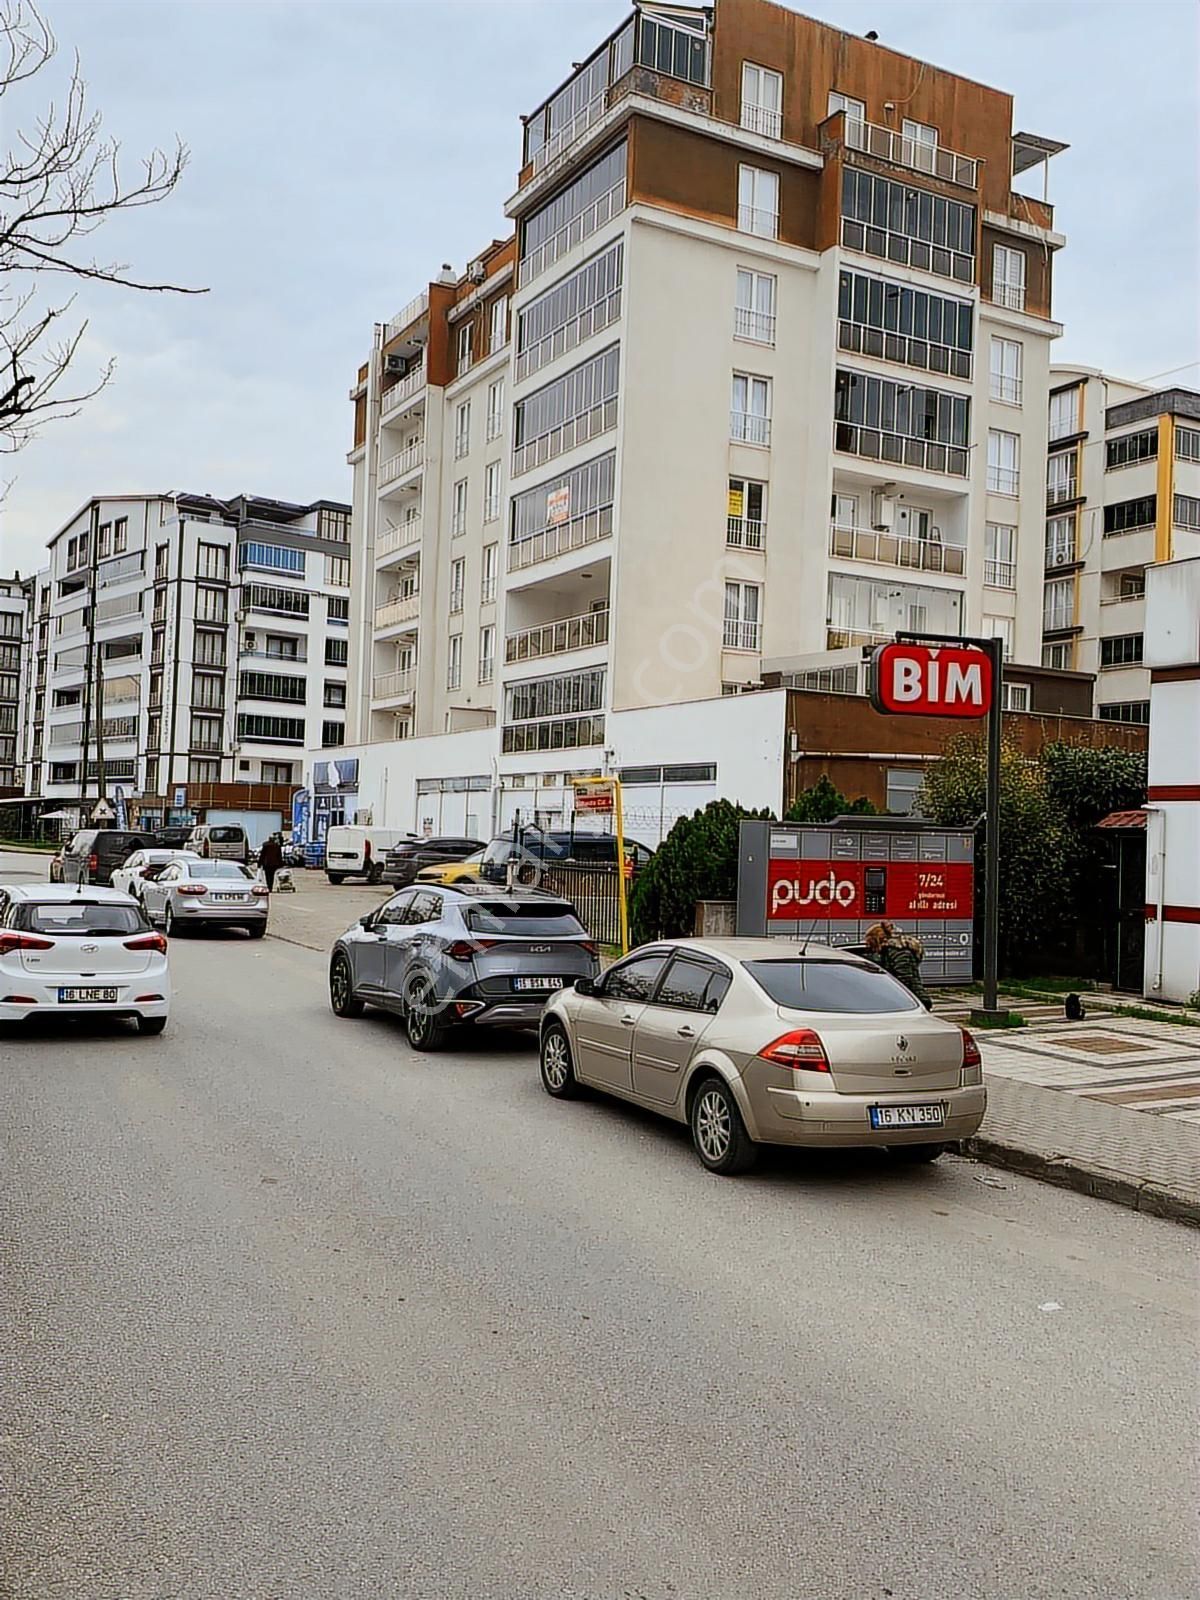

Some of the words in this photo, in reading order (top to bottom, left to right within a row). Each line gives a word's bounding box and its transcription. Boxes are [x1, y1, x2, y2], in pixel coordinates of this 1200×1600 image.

[892, 647, 983, 705] BİM
[919, 873, 943, 888] 7/24
[772, 871, 856, 915] pudo
[932, 899, 957, 909] adresi
[65, 989, 75, 1000] 16
[79, 989, 100, 1000] LNE
[103, 989, 115, 999] 80
[879, 1109, 892, 1124] 16
[896, 1108, 915, 1122] KN
[919, 1107, 940, 1121] 350
